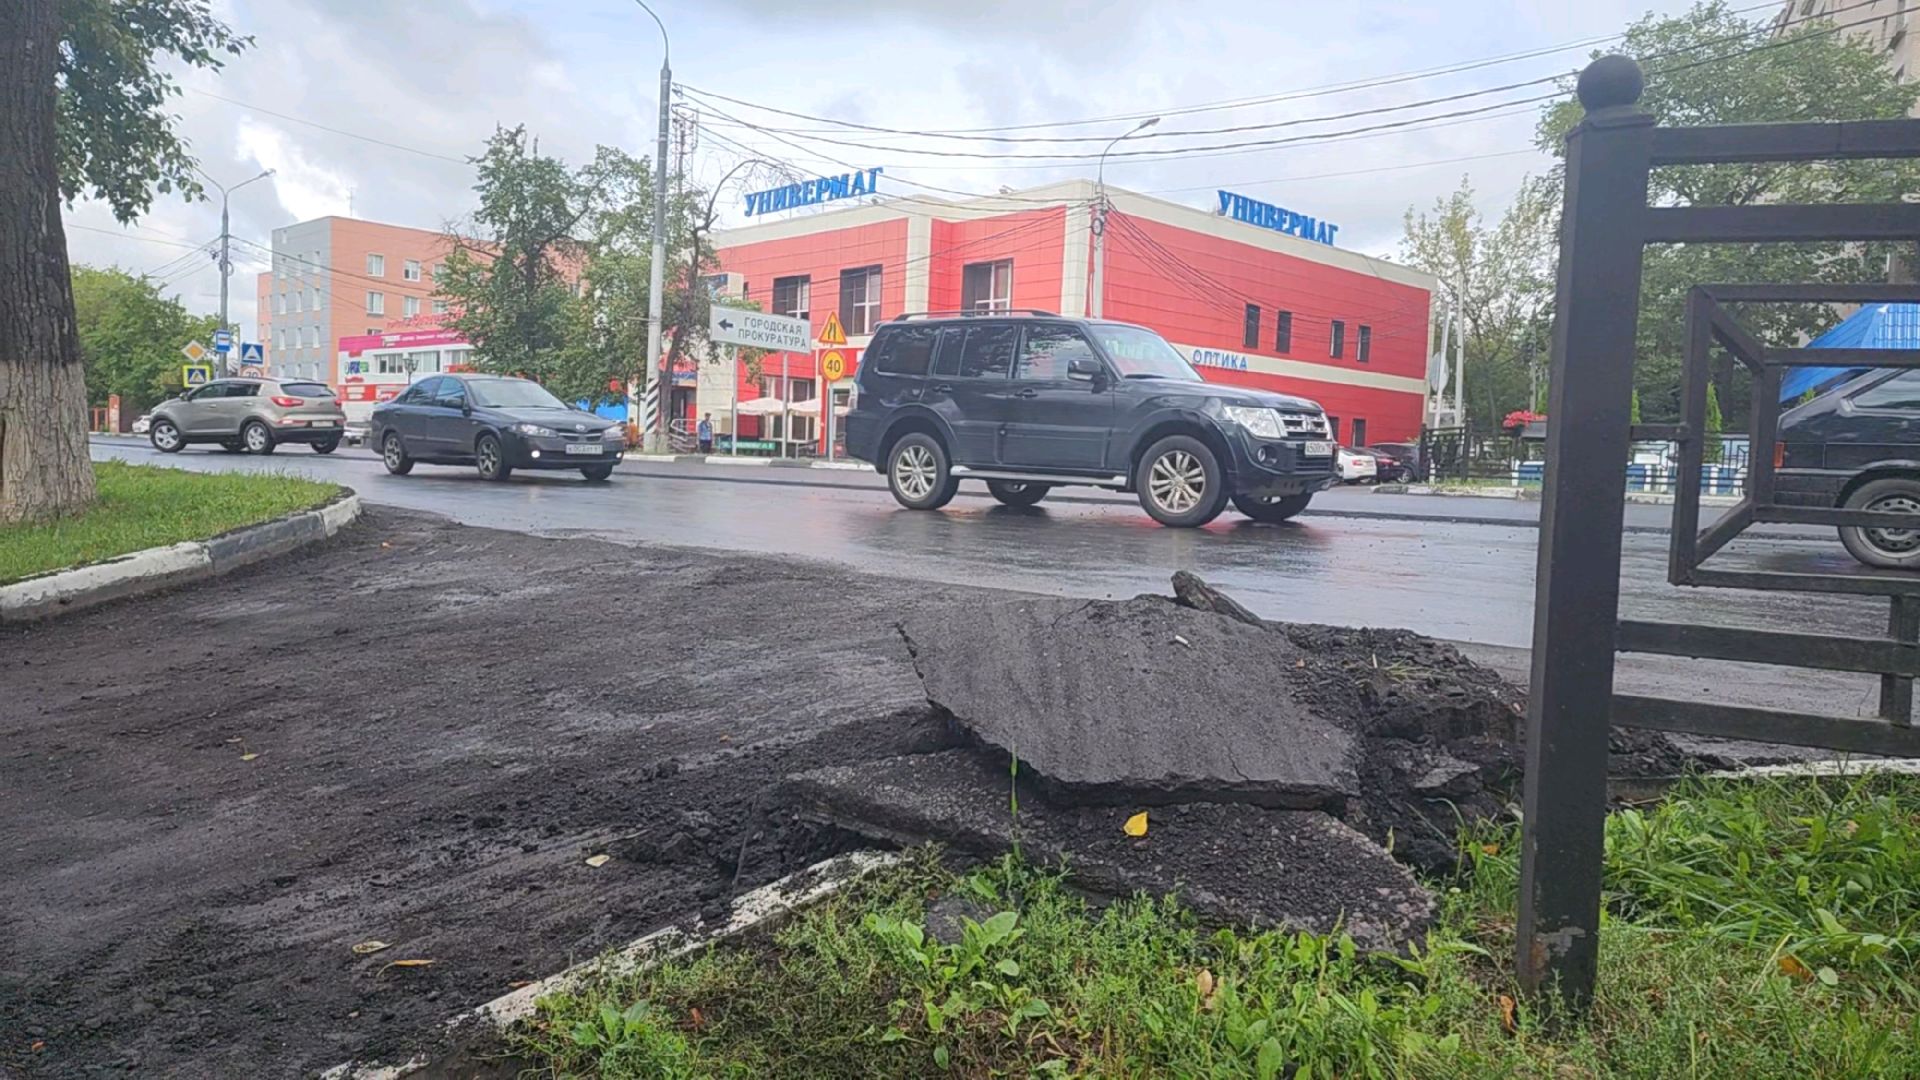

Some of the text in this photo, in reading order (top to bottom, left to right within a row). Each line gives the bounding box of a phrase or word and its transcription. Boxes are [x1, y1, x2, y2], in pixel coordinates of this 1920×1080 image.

[744, 168, 882, 217] УНИВЕРМАГ
[1217, 190, 1338, 246] УНИВЕРМАГ
[744, 316, 803, 336] ГОРОДСКАЯ
[738, 327, 807, 348] ПРОКУРАТУРА
[826, 359, 841, 373] 40
[1193, 349, 1248, 370] ОПТИКА
